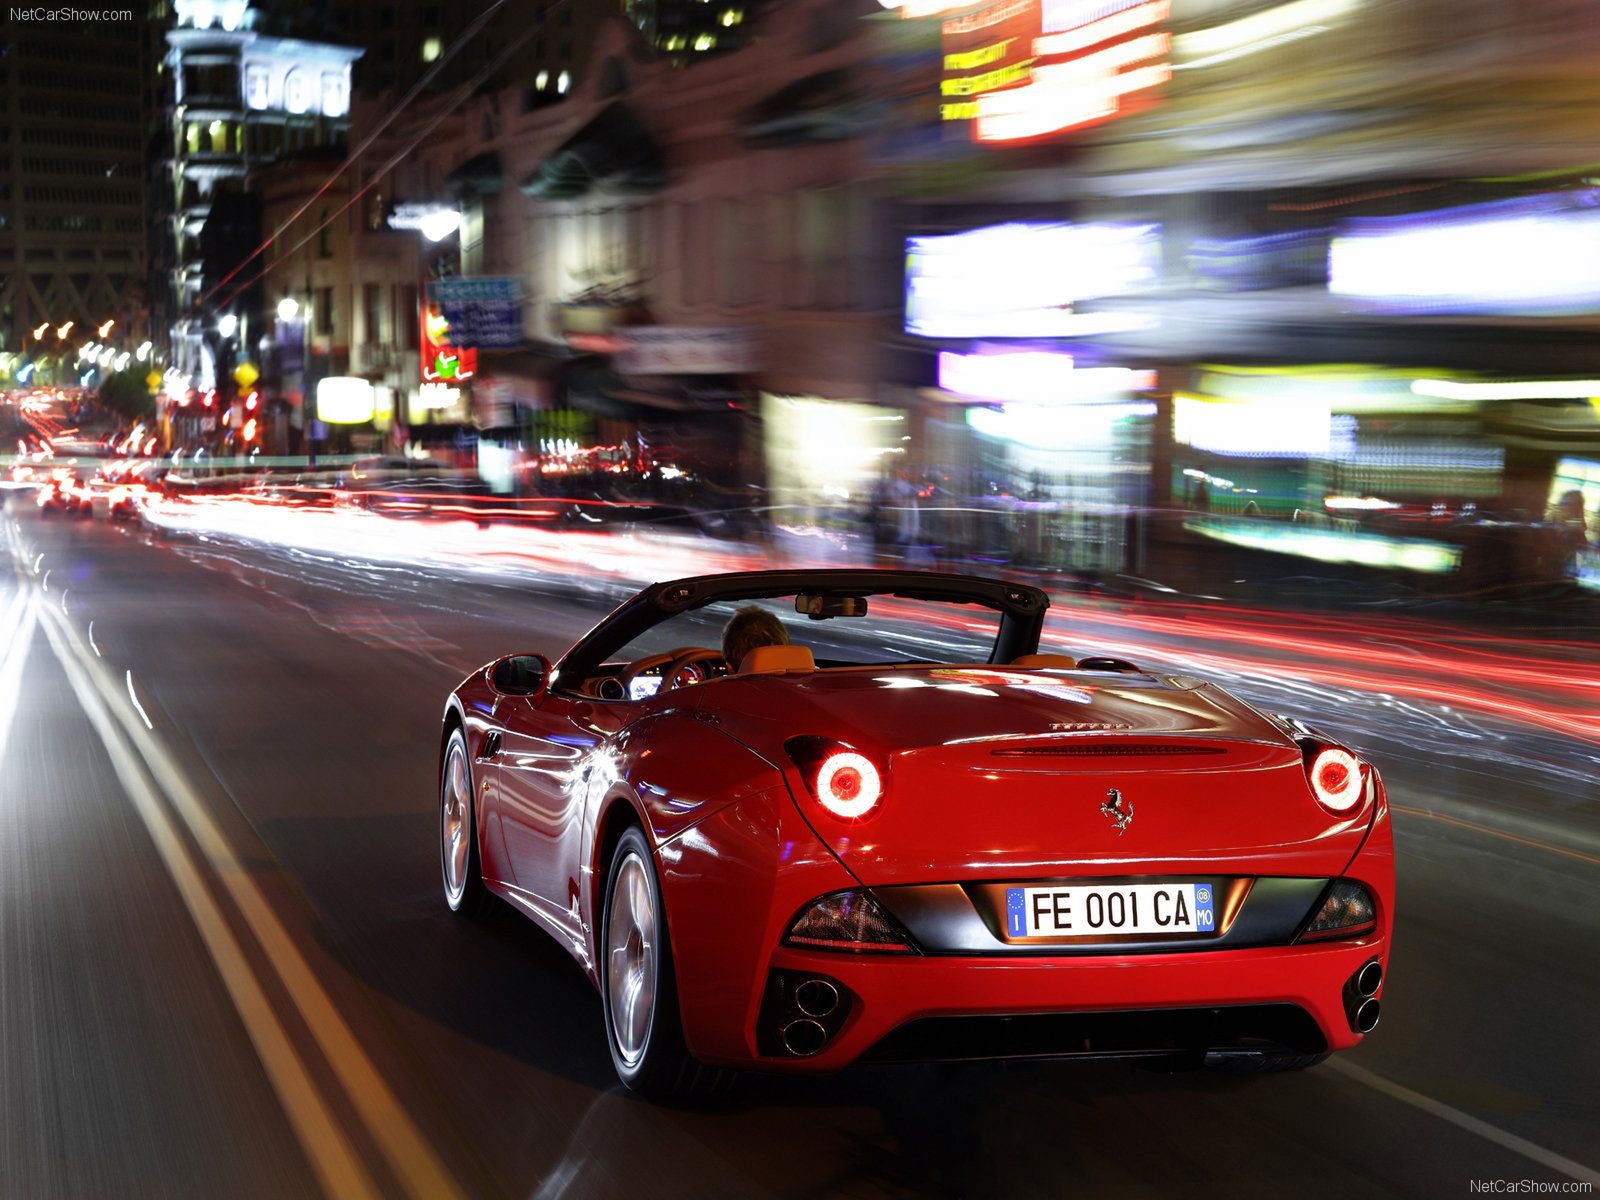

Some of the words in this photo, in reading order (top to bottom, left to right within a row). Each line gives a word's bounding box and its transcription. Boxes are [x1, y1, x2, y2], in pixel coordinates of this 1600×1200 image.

[1033, 893, 1072, 930] FE
[1086, 891, 1138, 928] 001
[1153, 889, 1191, 926] CA
[1196, 909, 1213, 926] MO
